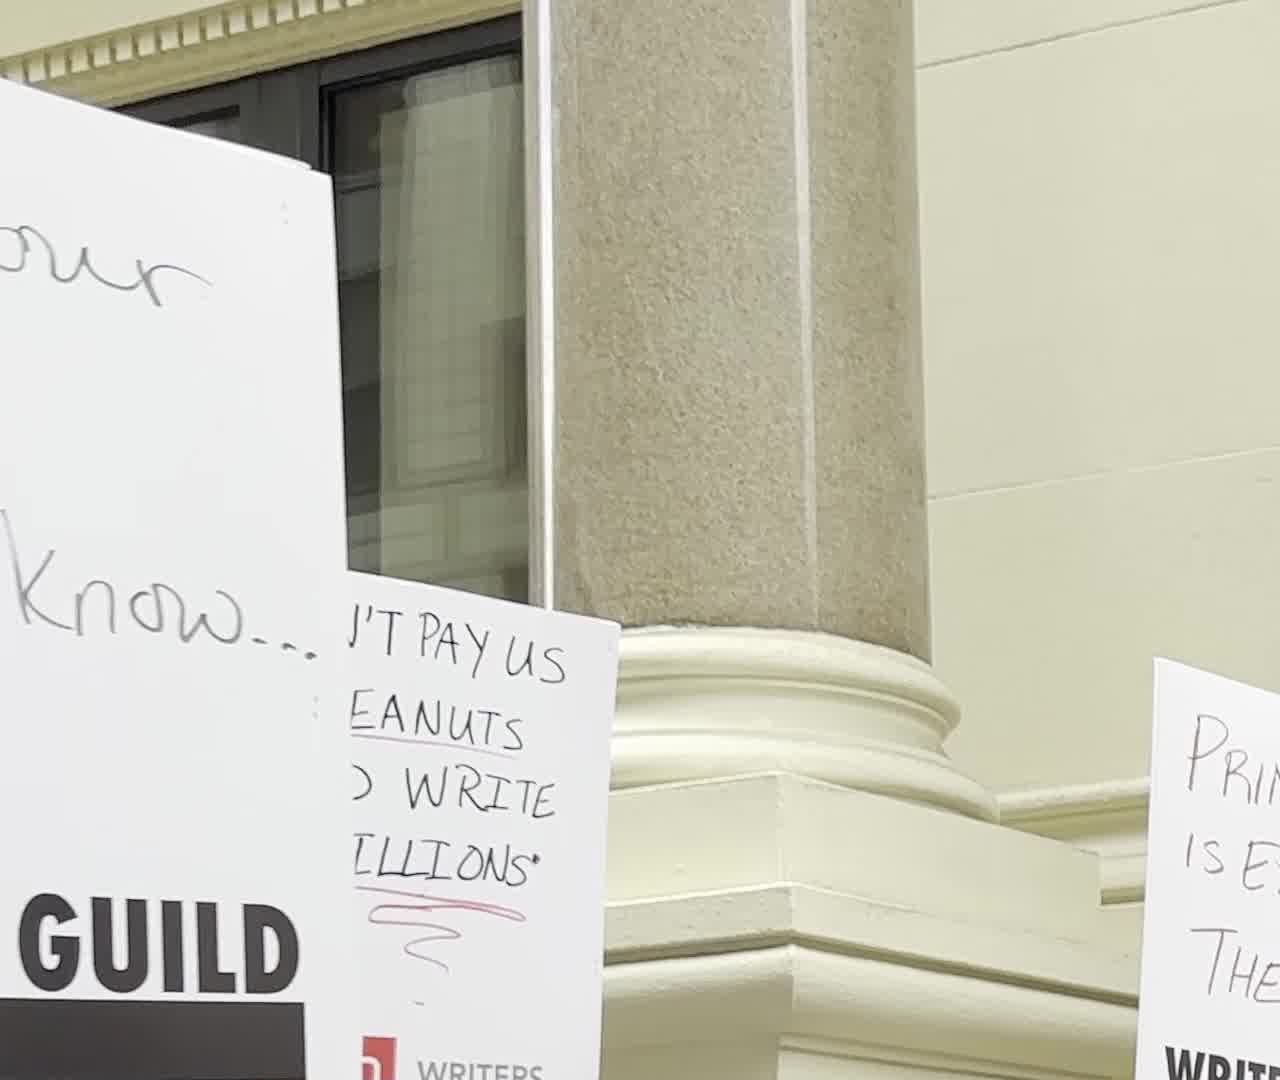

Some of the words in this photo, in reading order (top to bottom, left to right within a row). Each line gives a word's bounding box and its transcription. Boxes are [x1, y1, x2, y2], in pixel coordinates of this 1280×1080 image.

[419, 611, 490, 680] PAY
[506, 635, 566, 684] US
[351, 688, 524, 750] EANUTS
[404, 763, 557, 819] WRITE
[1185, 831, 1225, 875] IS
[18, 892, 299, 995] GUILD
